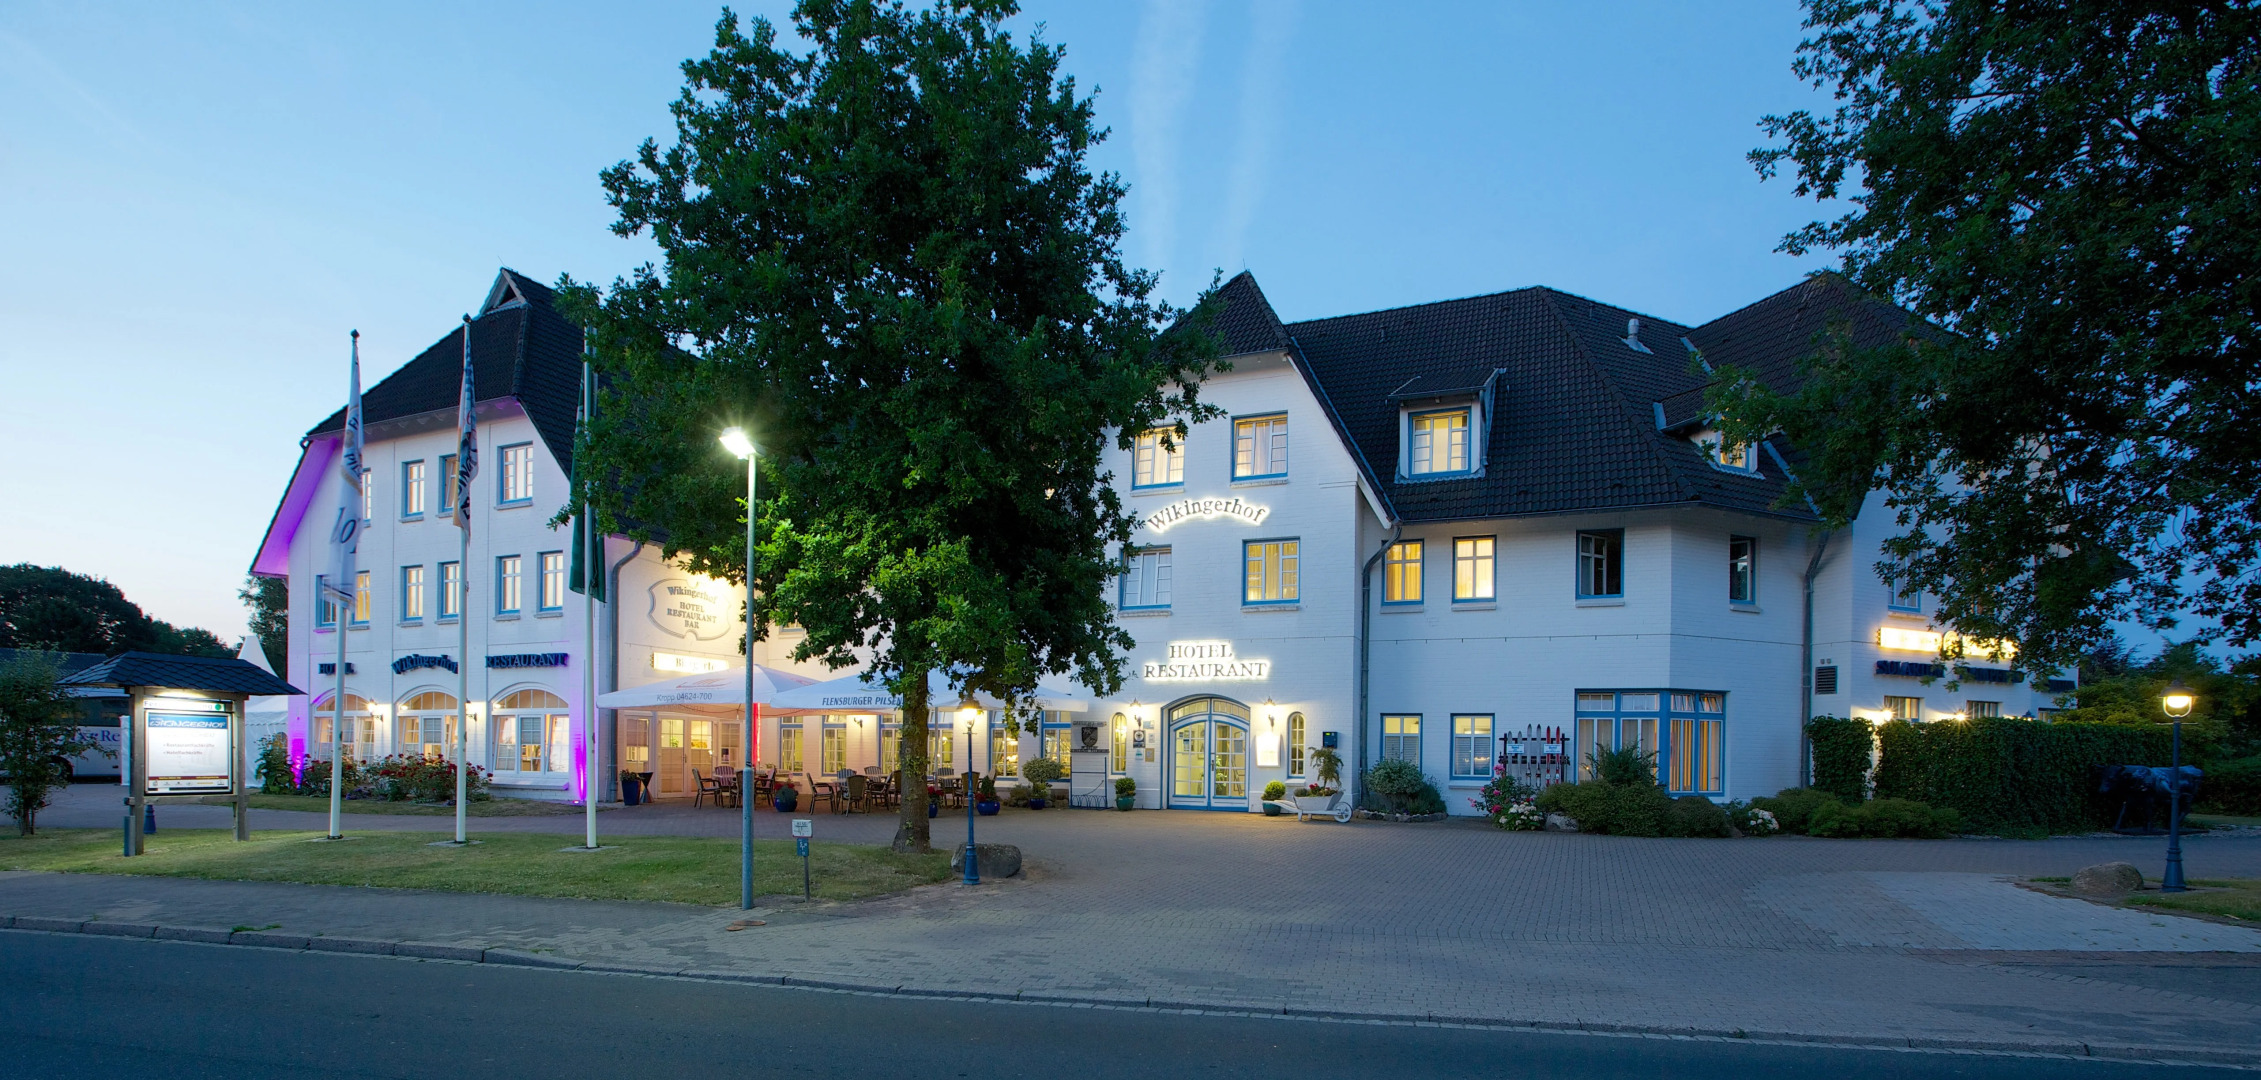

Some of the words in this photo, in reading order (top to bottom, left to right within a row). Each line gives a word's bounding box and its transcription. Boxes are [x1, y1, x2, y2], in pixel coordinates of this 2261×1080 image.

[1147, 498, 1266, 529] Wikingerhof
[666, 586, 718, 604] Wikingerhof
[679, 601, 705, 613] HOTEL
[667, 608, 717, 623] RESTAURANT
[684, 619, 700, 629] BAR
[1169, 644, 1233, 659] HOTEL
[391, 653, 459, 674] Wikingerhof
[485, 653, 569, 668] RESTAURANT
[318, 662, 355, 675] HOL
[1144, 662, 1267, 678] RESTAURANT
[656, 694, 675, 702] Kropp
[676, 693, 713, 701] 04624-700
[821, 696, 872, 706] FLENSBURGER
